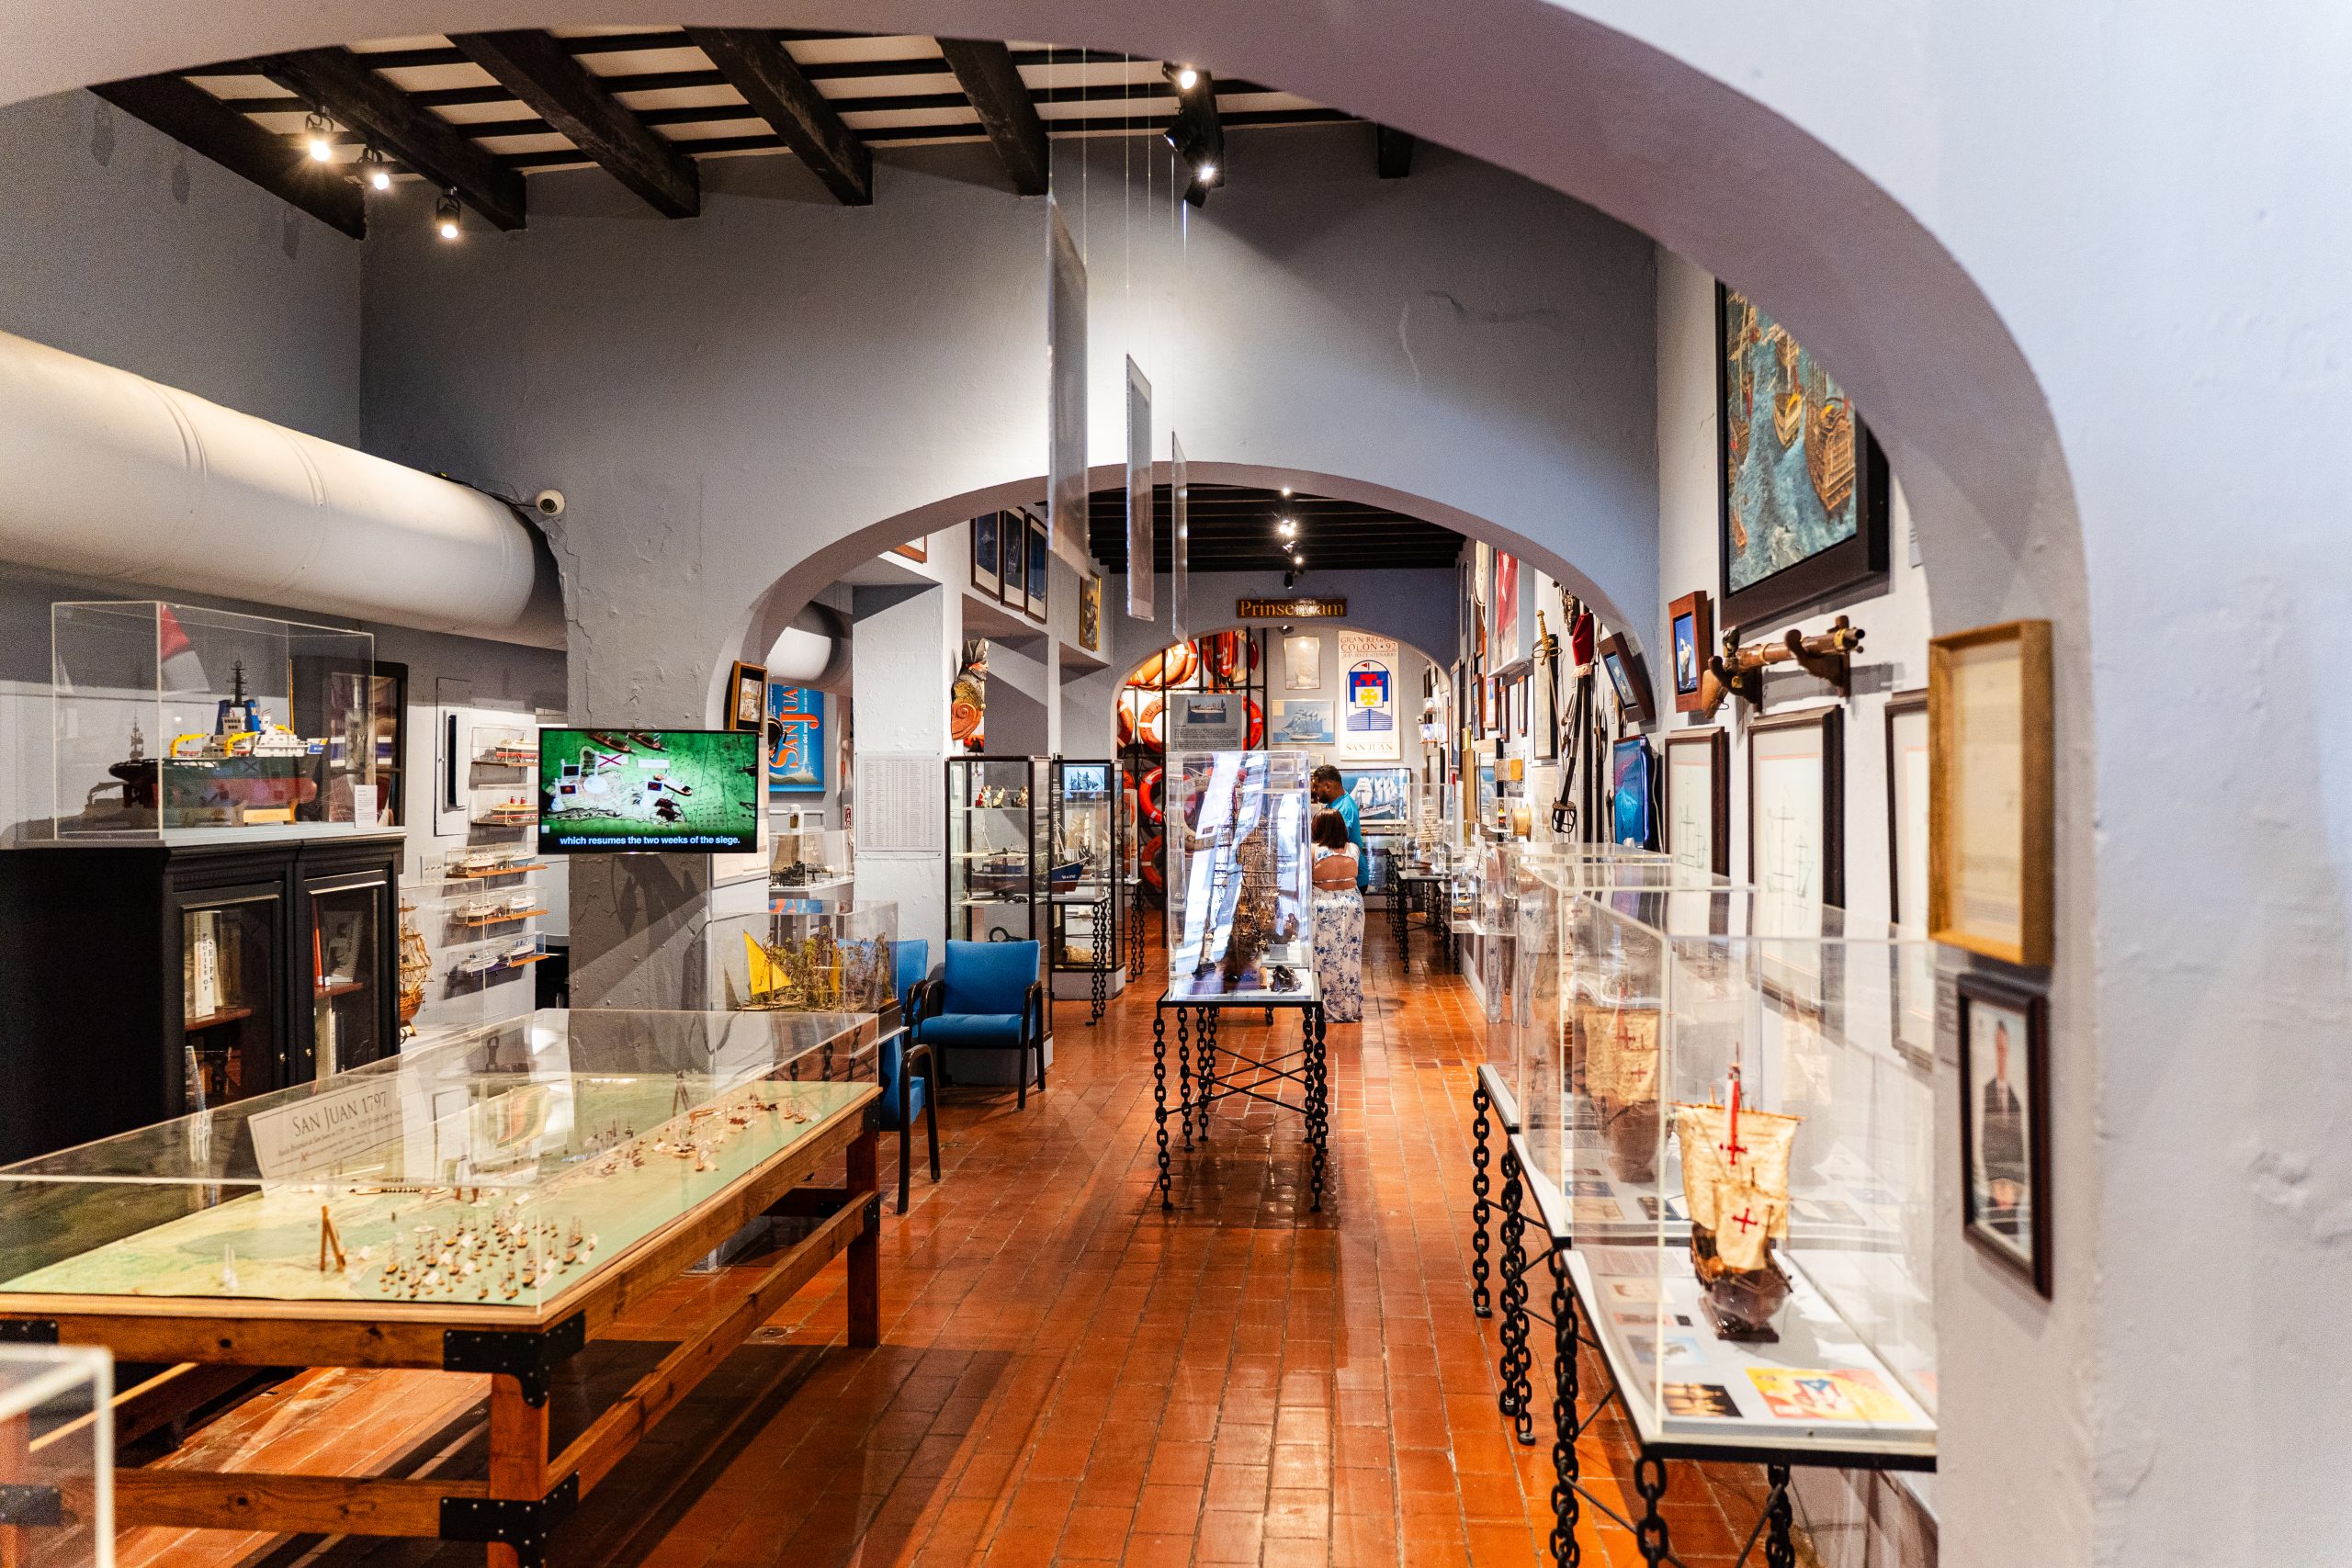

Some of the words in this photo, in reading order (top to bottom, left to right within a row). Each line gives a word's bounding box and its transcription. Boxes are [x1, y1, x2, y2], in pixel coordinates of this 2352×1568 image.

[1240, 600, 1344, 616] Prinsendam
[1340, 643, 1377, 651] COLON
[779, 685, 820, 729] JUA
[560, 836, 586, 844] which
[628, 836, 642, 844] the
[661, 836, 688, 844] weeks
[690, 836, 699, 844] of
[700, 836, 714, 844] the
[716, 836, 741, 846] siege.
[292, 1111, 321, 1137] SAN
[323, 1100, 357, 1132] JUAN
[361, 1091, 387, 1115] 1797
